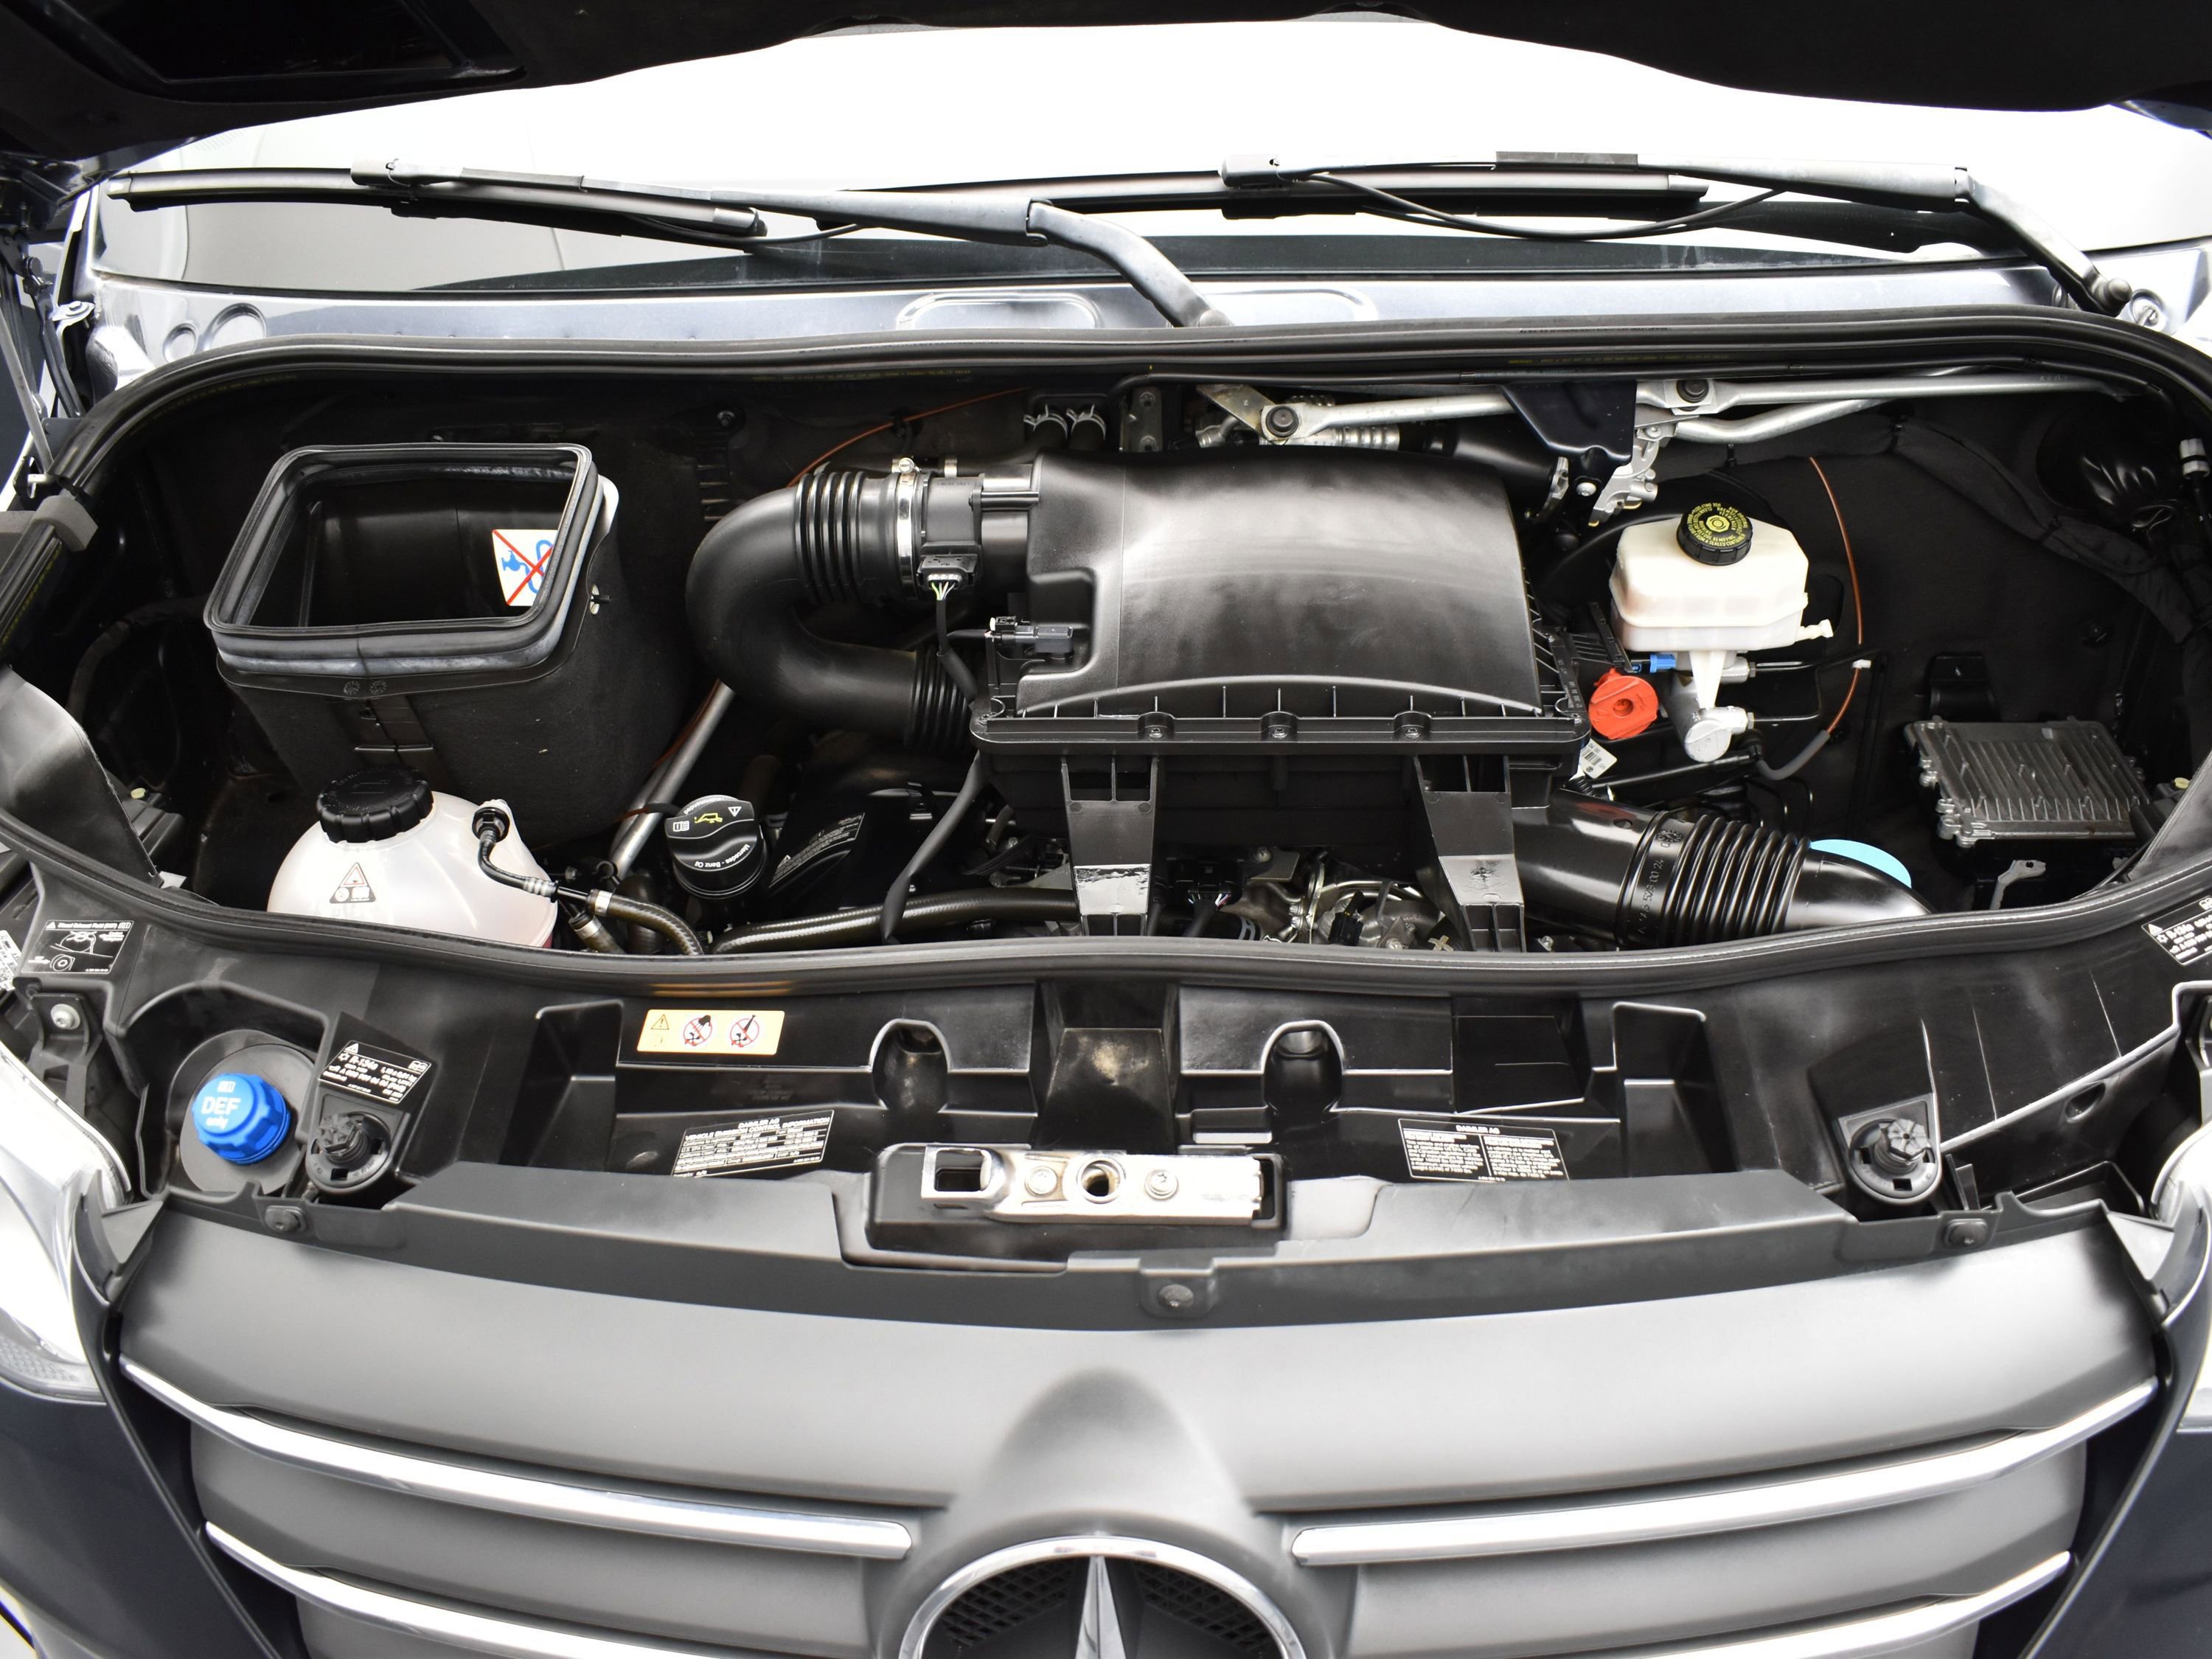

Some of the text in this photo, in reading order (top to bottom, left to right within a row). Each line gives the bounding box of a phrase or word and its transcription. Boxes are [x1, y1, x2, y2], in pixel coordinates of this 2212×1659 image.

[201, 1096, 240, 1115] DEF
[206, 1116, 229, 1130] only
[685, 1132, 714, 1141] VEHICLE
[748, 1124, 781, 1133] CONTROL
[782, 1117, 830, 1128] INFORMATION
[738, 1119, 768, 1129] DAIMLER
[1455, 1124, 1489, 1133] DAIMLER
